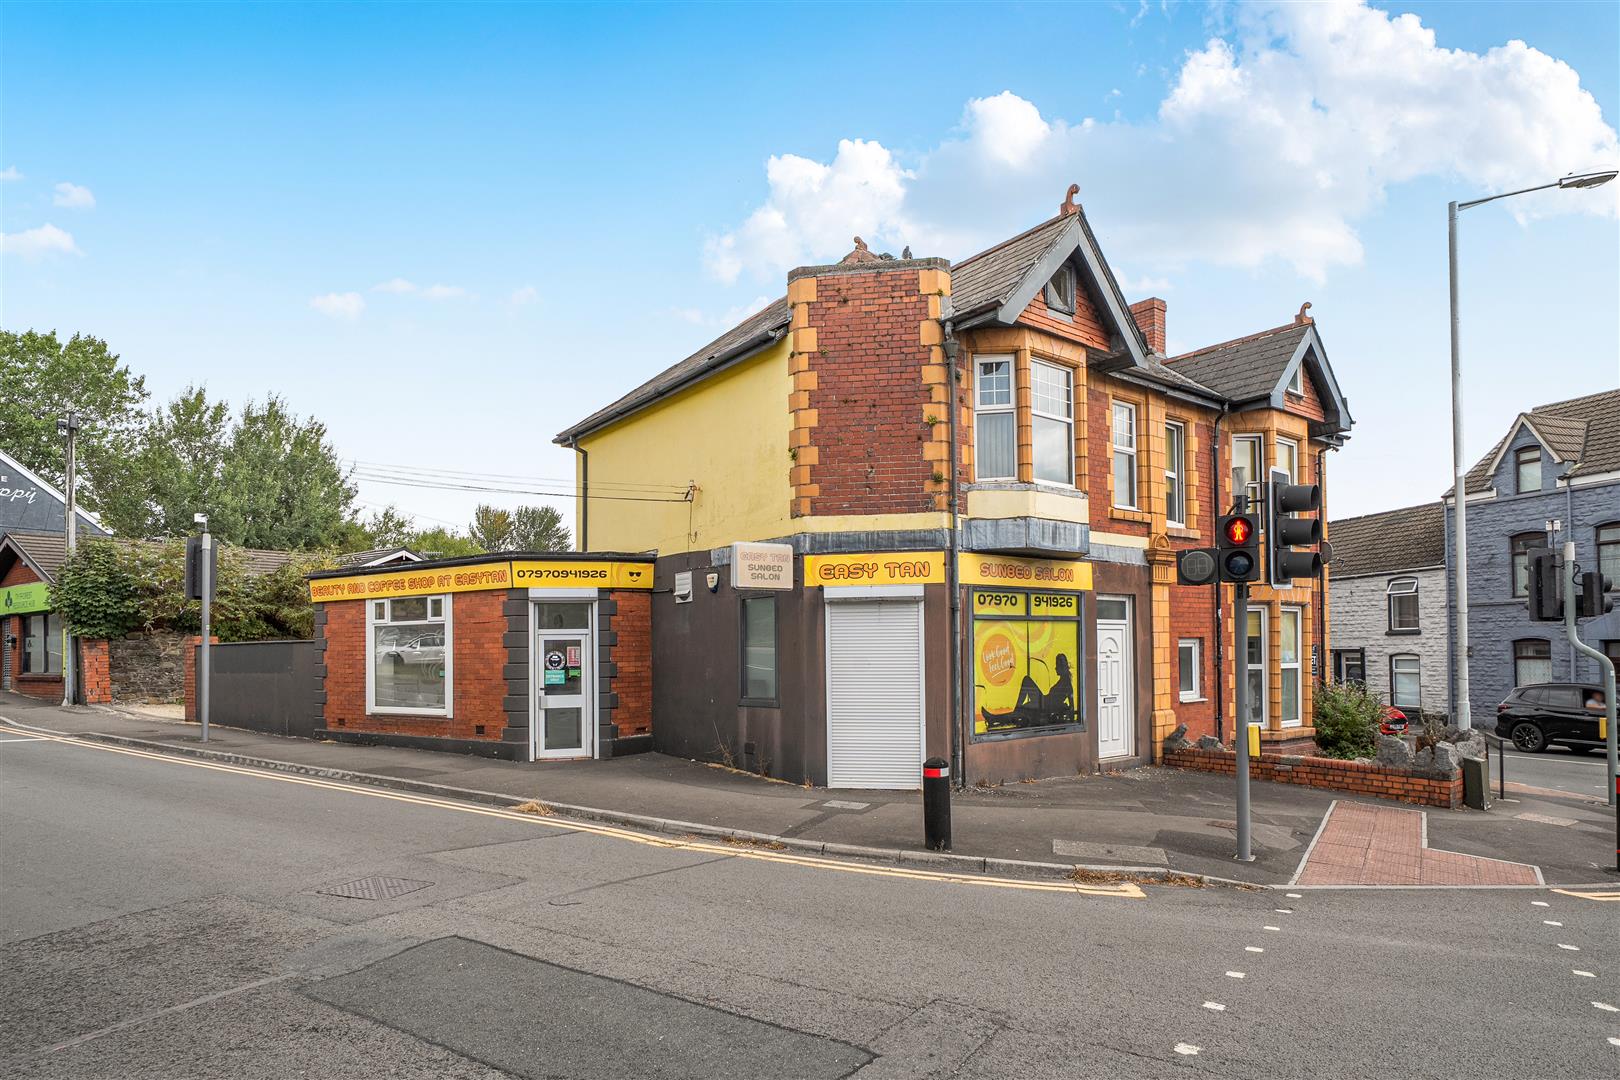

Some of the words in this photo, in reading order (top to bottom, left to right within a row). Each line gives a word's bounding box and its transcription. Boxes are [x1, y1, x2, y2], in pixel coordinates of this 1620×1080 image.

[740, 551, 769, 562] EASY
[770, 553, 791, 564] TAN
[517, 569, 608, 579] 07970941926
[748, 563, 783, 572] SUNBED
[819, 563, 879, 580] EASY
[884, 561, 930, 578] TAN
[980, 562, 1032, 580] SUNBED
[1035, 567, 1074, 582] SALON
[312, 583, 346, 598] BEAUTY
[347, 582, 366, 595] AND
[367, 578, 406, 593] COFFEE
[408, 575, 435, 590] SHOP
[437, 574, 452, 588] AT
[454, 569, 507, 587] EASYTAN
[750, 572, 781, 581] SALON
[977, 593, 1018, 606] 07970
[1034, 596, 1073, 608] 941926
